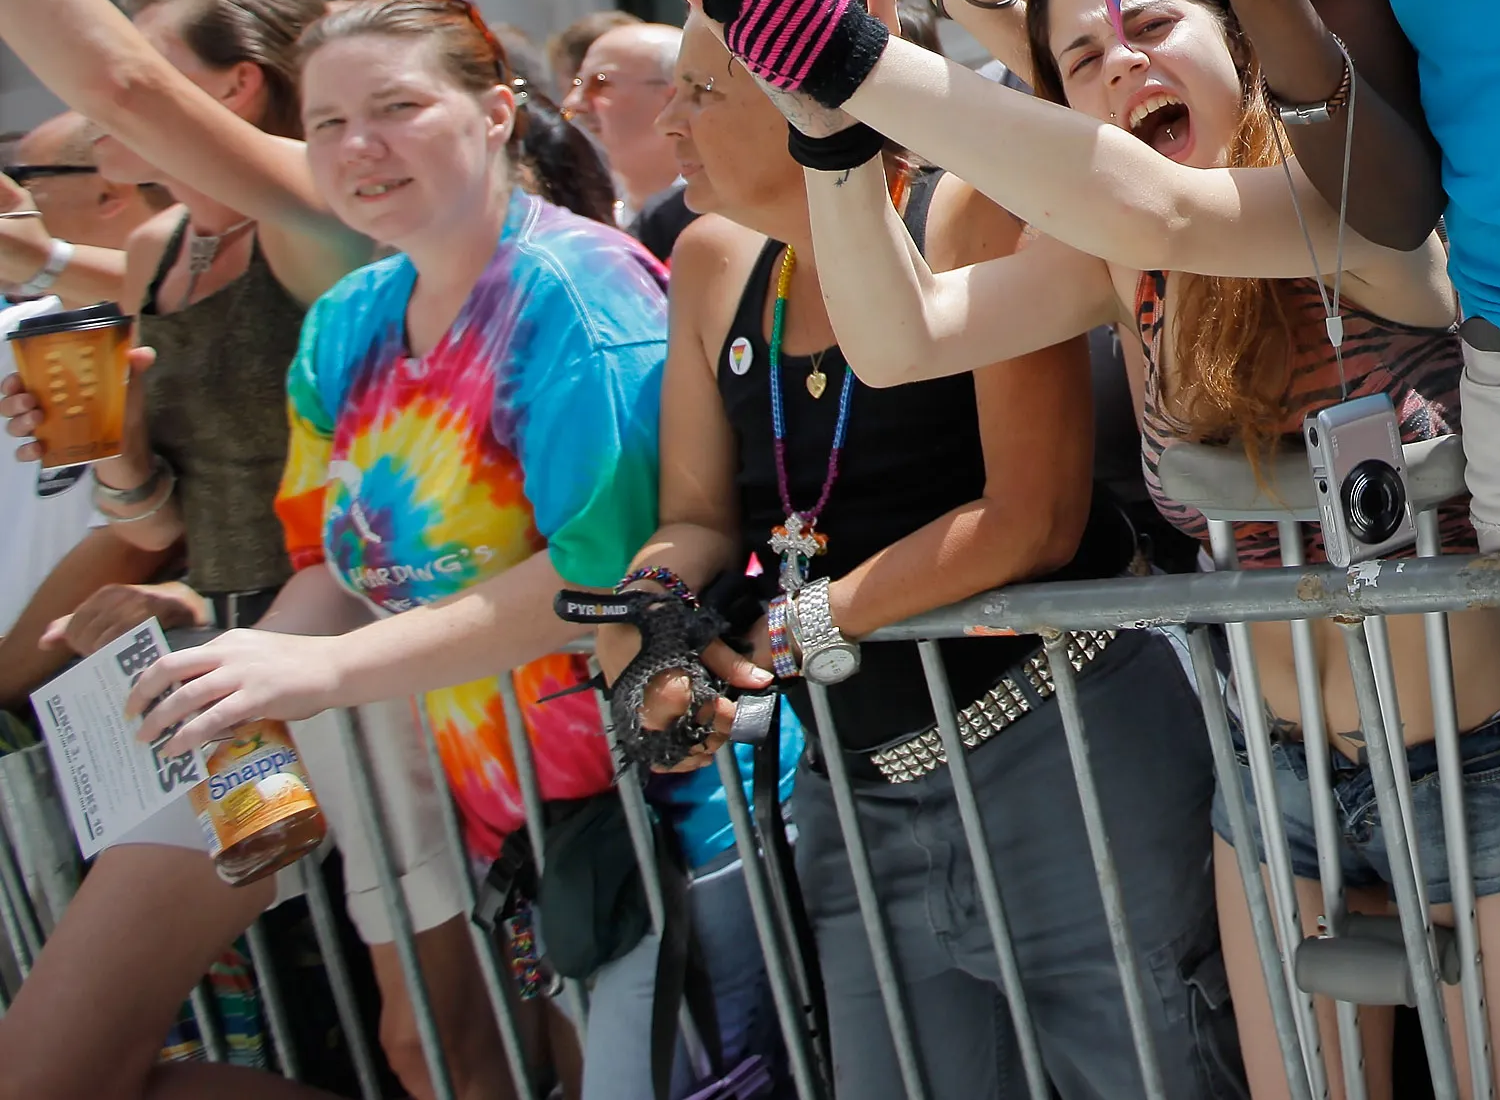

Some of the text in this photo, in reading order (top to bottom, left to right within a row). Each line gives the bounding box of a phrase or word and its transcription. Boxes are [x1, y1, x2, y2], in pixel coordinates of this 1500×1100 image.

[349, 545, 494, 590] HARDING'S
[51, 694, 76, 744] DANCE
[77, 764, 98, 815] LOOKS
[93, 818, 104, 837] 10
[209, 747, 298, 800] Snapple
